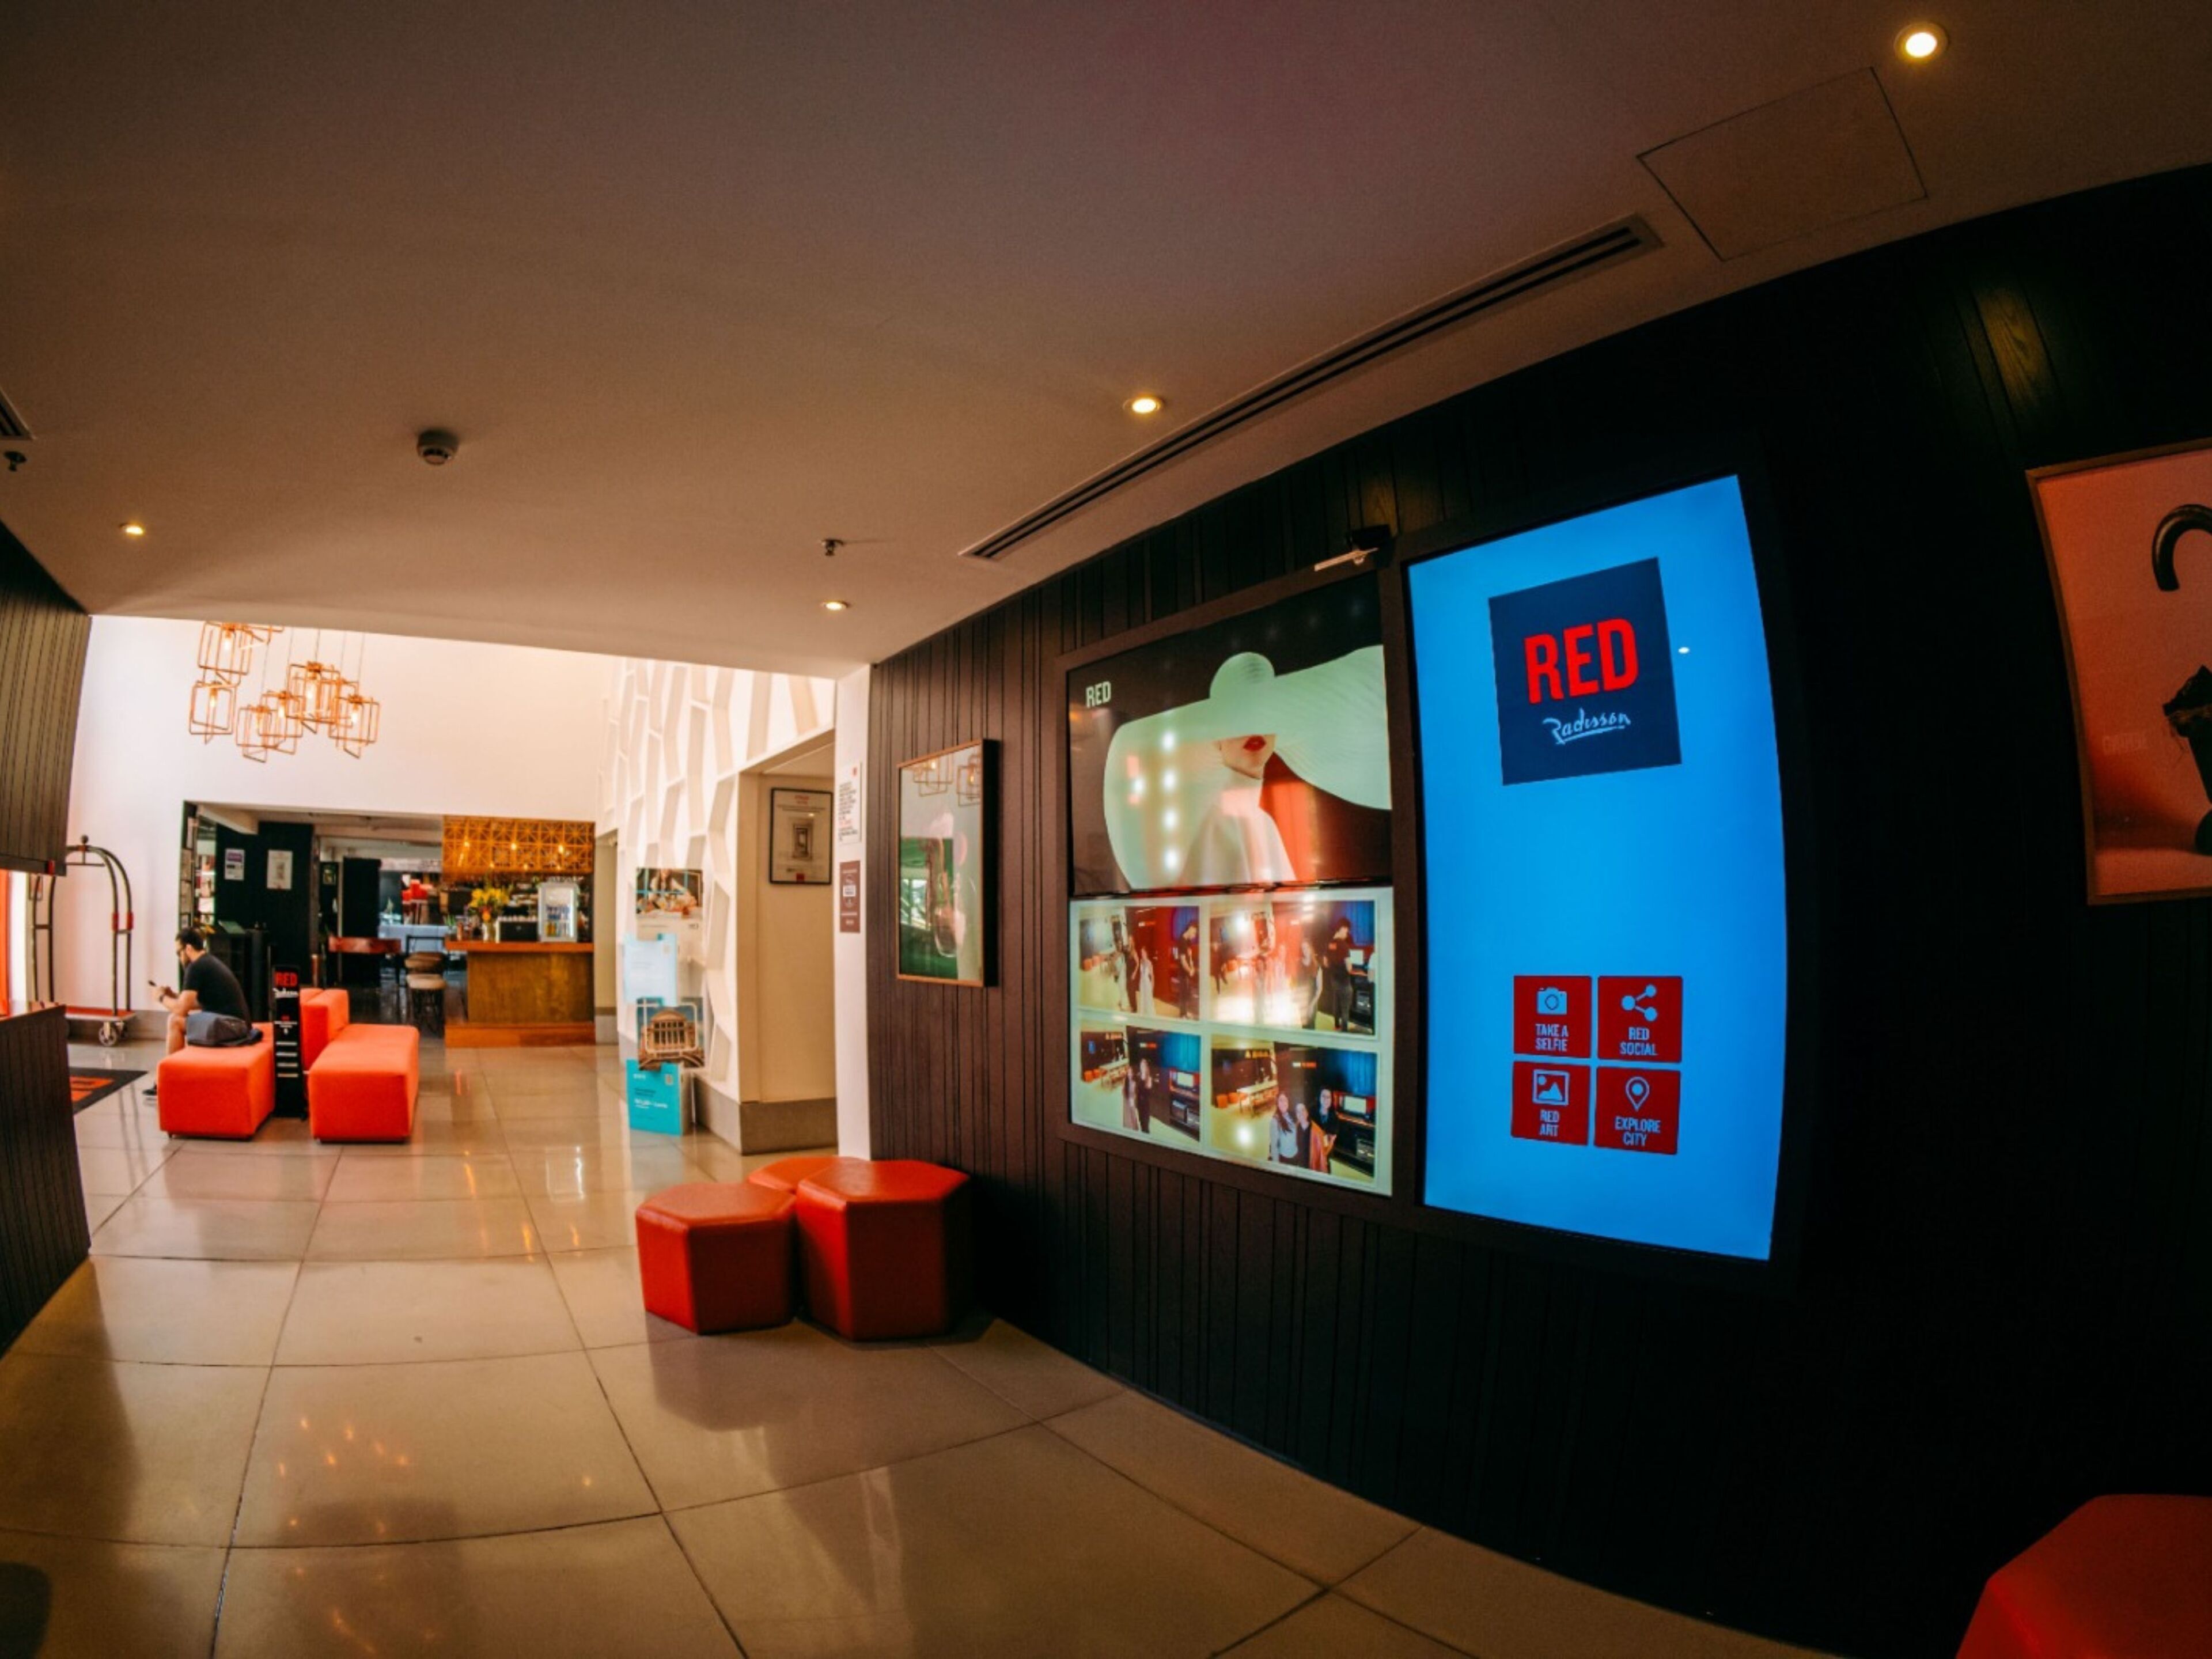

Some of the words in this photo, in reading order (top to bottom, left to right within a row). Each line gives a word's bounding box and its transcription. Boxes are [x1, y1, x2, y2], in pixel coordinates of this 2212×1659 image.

[1524, 618, 1639, 704] RED
[1086, 681, 1112, 709] RED
[1542, 708, 1631, 744] Radisson
[1535, 1023, 1560, 1037] TAKE
[1562, 1025, 1569, 1037] A
[1628, 1027, 1650, 1040] RED
[1535, 1037, 1567, 1052] SELFIE
[1620, 1042, 1658, 1056] SOCIAL
[1540, 1109, 1559, 1123] RED
[1540, 1124, 1558, 1137] ART
[1615, 1116, 1661, 1134] EXPLORE
[1623, 1132, 1647, 1146] CITY
